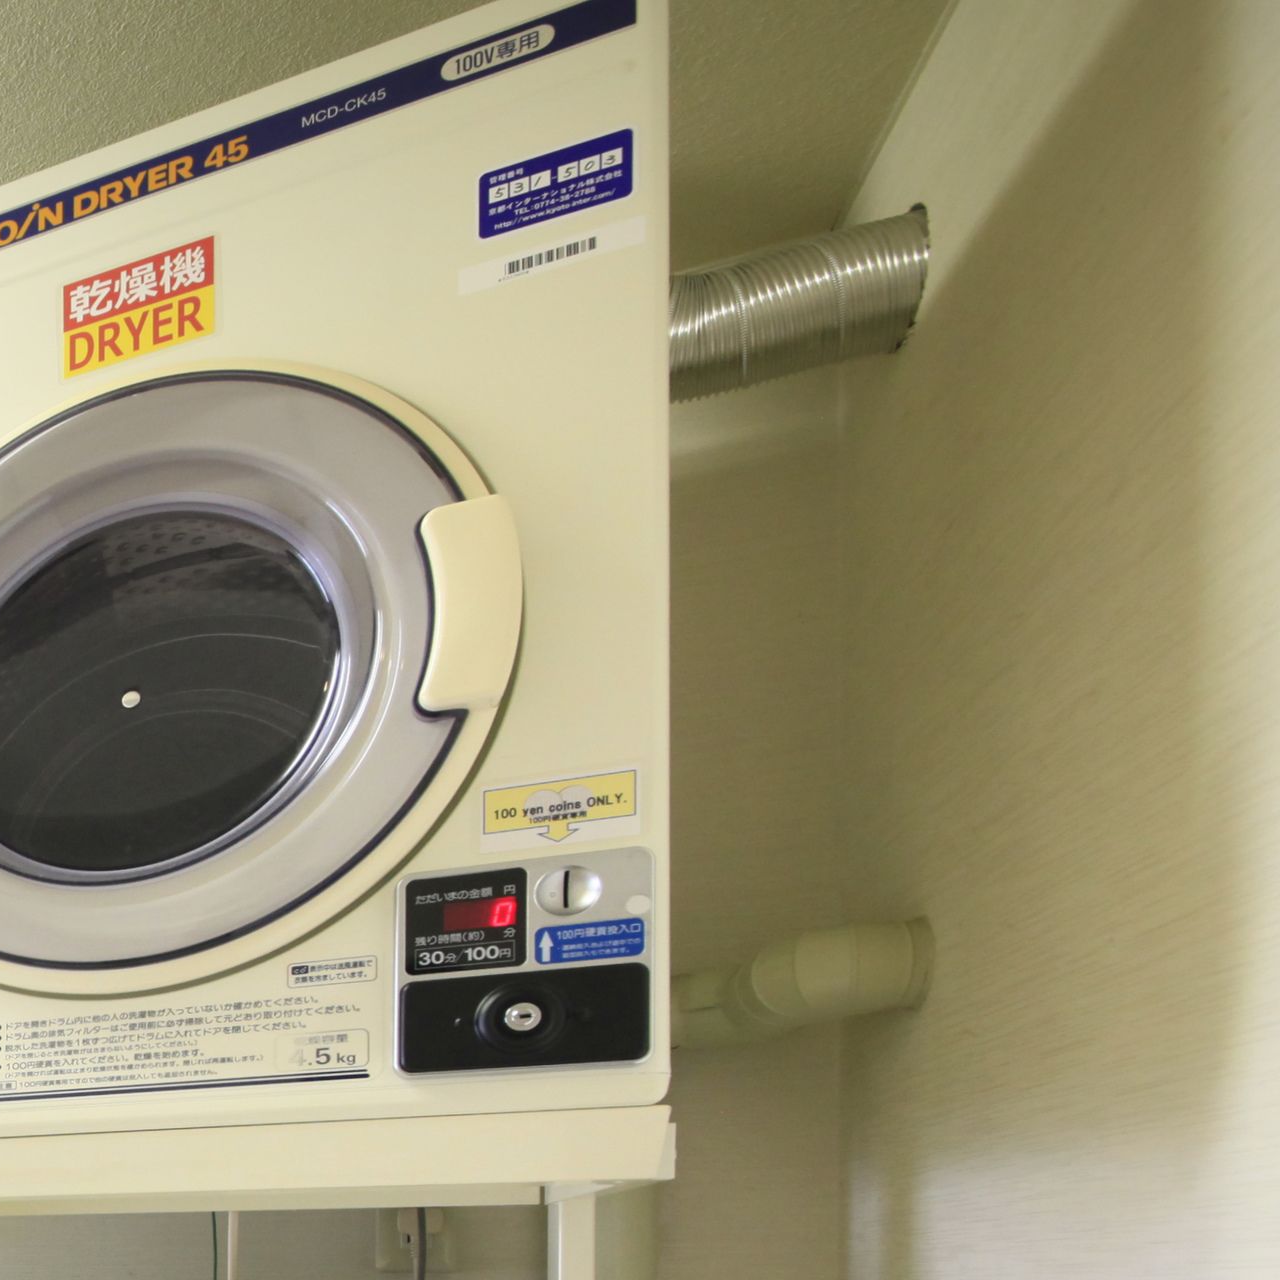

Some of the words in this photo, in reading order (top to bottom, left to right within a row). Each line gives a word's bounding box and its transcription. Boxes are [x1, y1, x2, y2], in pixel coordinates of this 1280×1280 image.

[455, 30, 540, 75] 100V専用
[301, 88, 388, 128] MCD-CK45
[73, 155, 195, 219] DRYER
[203, 135, 250, 168] 45
[69, 246, 205, 323] 乾燥機
[69, 295, 205, 371] DRYER
[494, 807, 517, 820] 100
[522, 806, 544, 817] yen
[548, 801, 582, 813] coins
[415, 887, 493, 905] ただいまの金額
[503, 885, 516, 895] 円
[493, 901, 513, 927] 0
[503, 928, 516, 938] 分
[336, 1053, 356, 1066] kg
